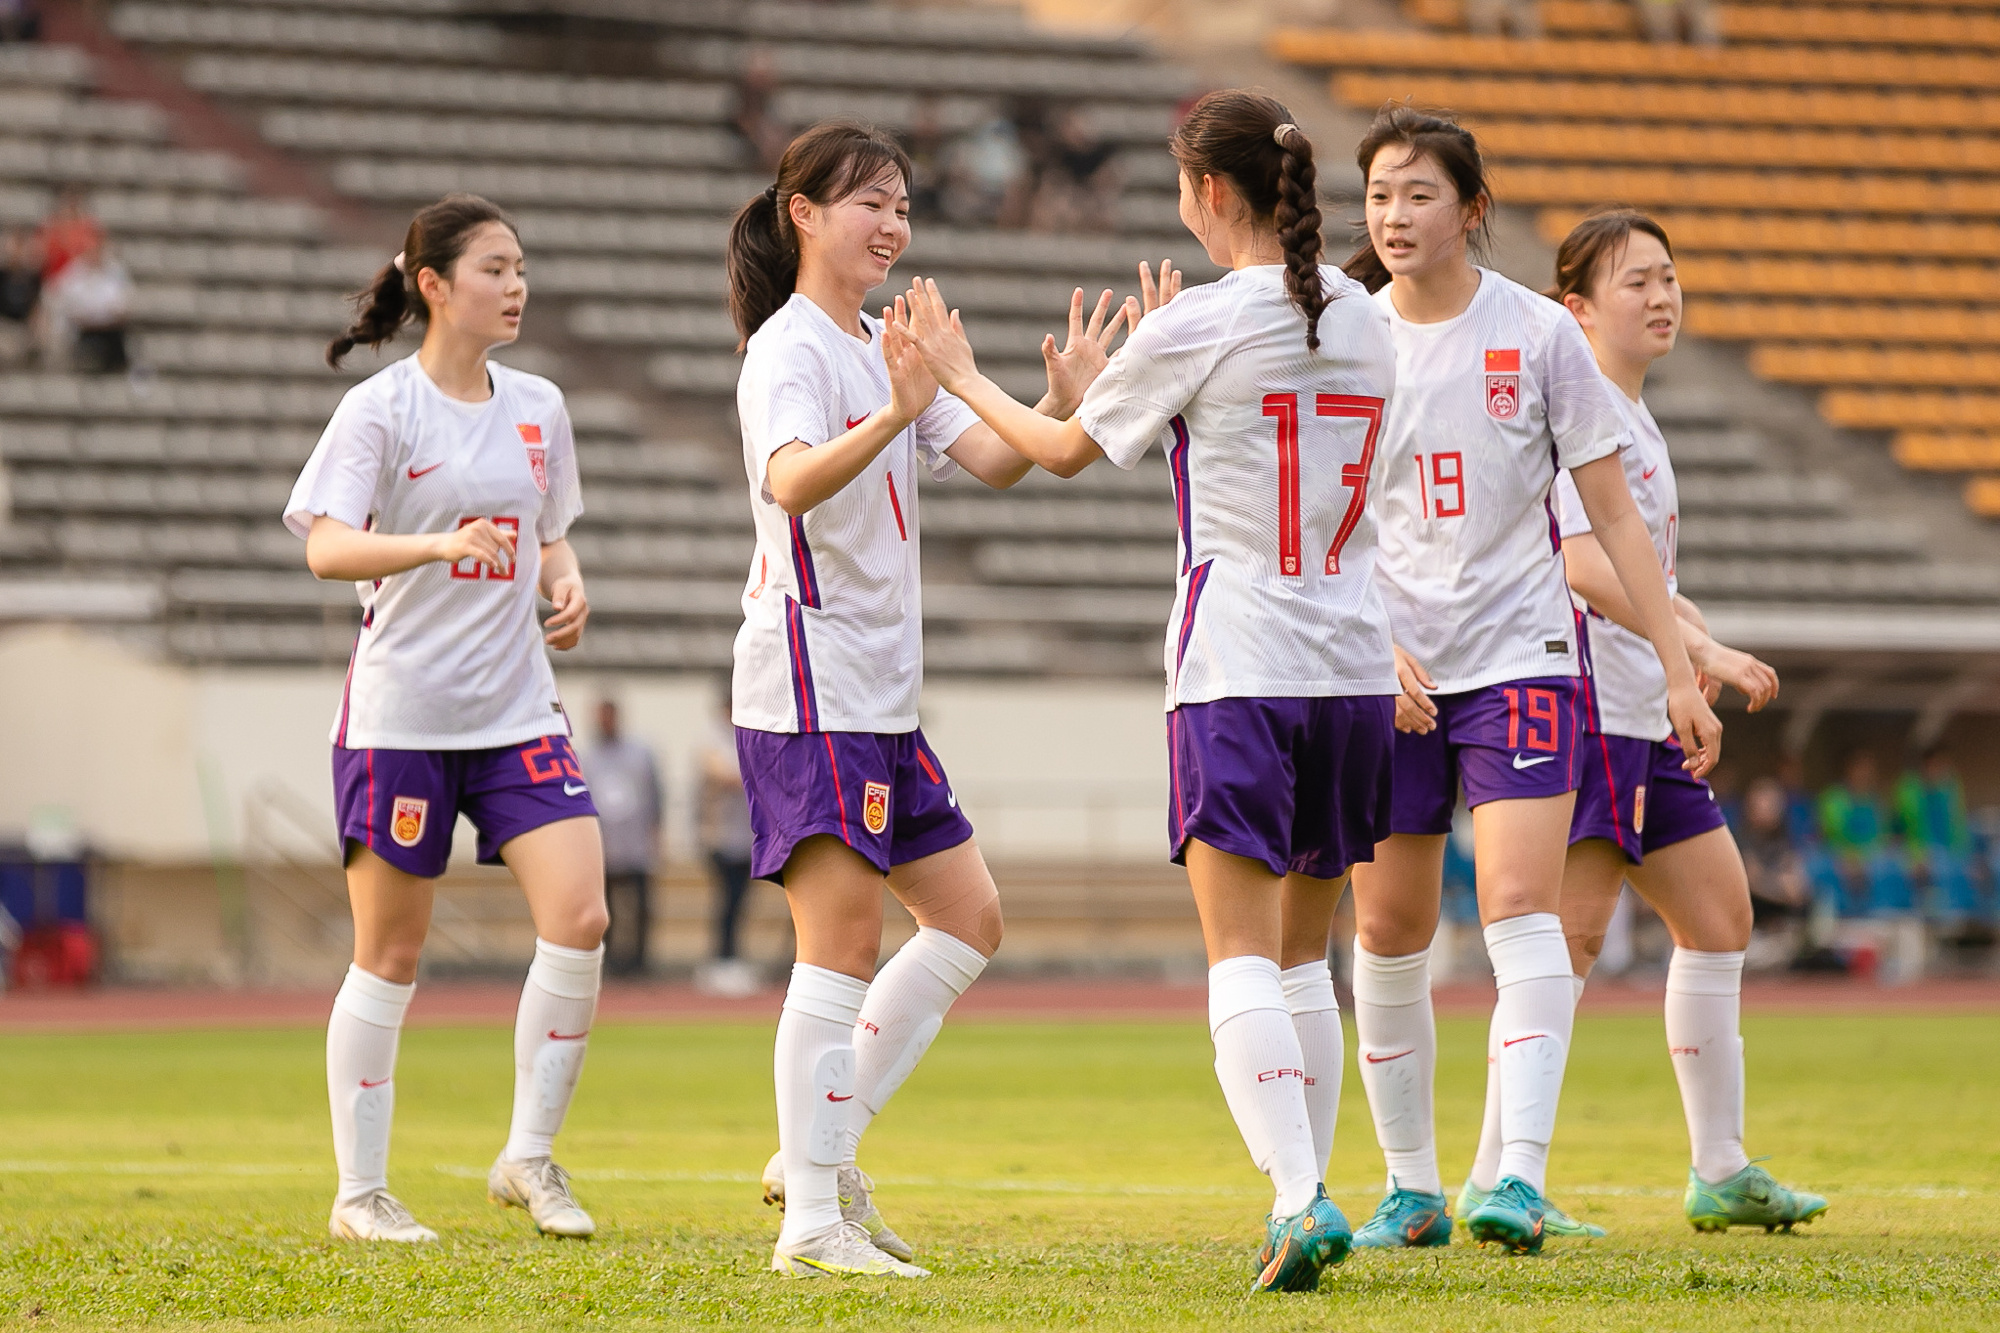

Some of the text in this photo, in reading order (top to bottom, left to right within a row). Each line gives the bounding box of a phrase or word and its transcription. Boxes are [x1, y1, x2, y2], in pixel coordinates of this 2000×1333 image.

[1490, 379, 1515, 389] CFA
[1262, 393, 1386, 577] 17
[1414, 451, 1466, 519] 19
[1503, 688, 1559, 752] 19
[868, 787, 886, 799] CFA
[1258, 1068, 1303, 1083] CFA
